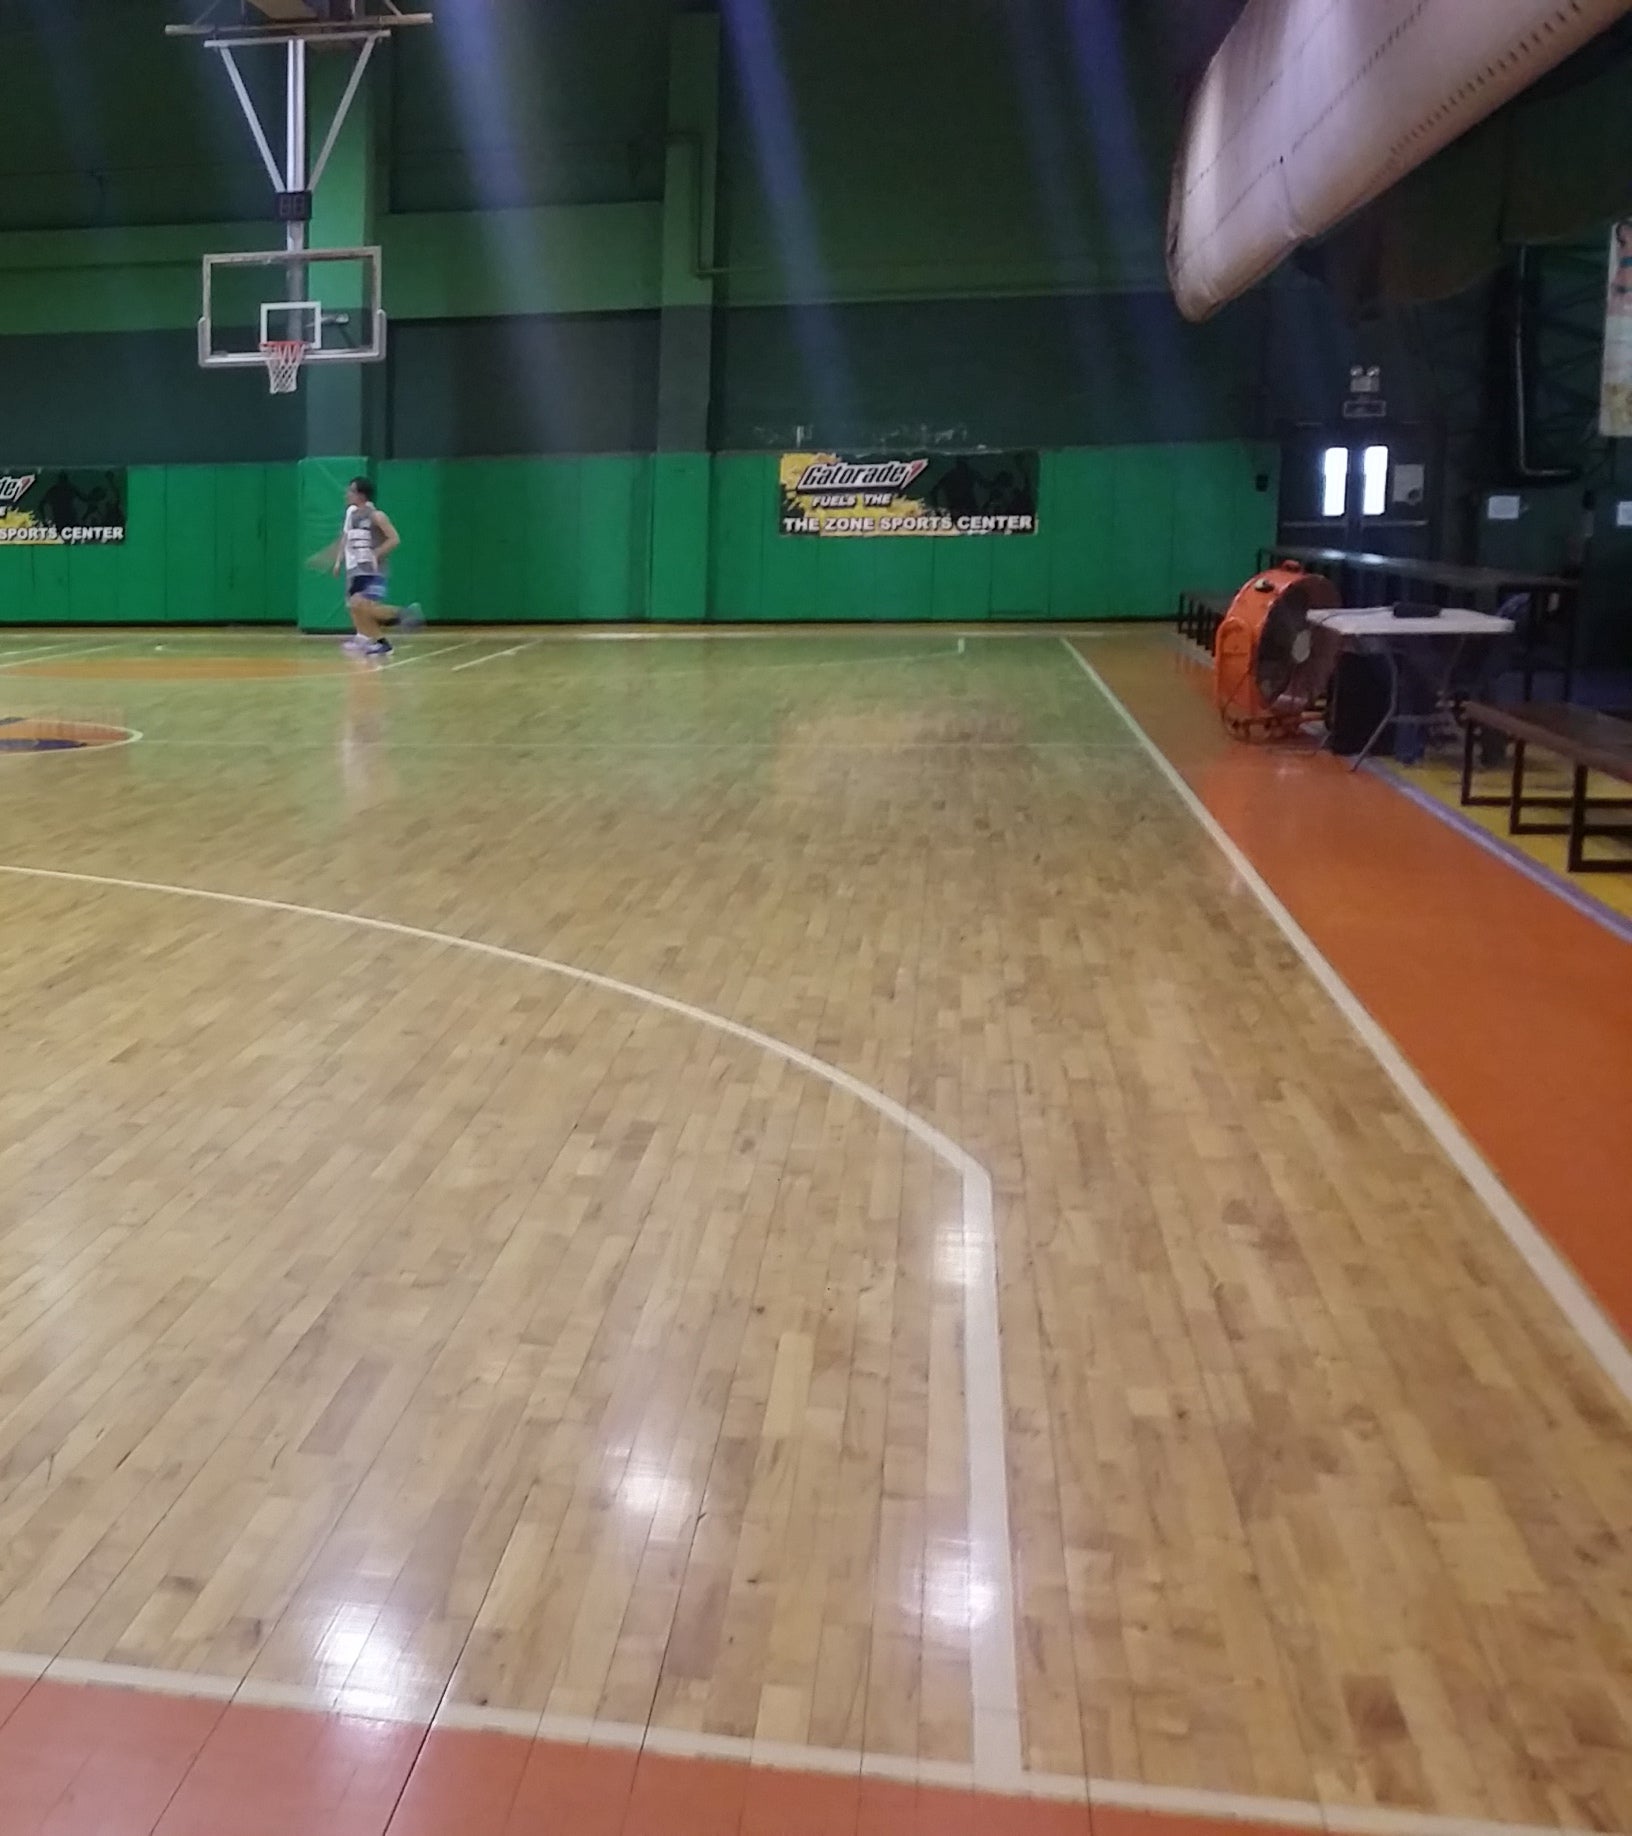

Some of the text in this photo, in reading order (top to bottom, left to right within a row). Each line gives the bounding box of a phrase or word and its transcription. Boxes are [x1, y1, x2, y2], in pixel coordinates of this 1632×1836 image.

[800, 462, 908, 489] Gatorade
[812, 493, 892, 507] FUELS THE
[784, 515, 1033, 532] THE ZONE SPORTS CENTER
[60, 527, 125, 540] CENTER
